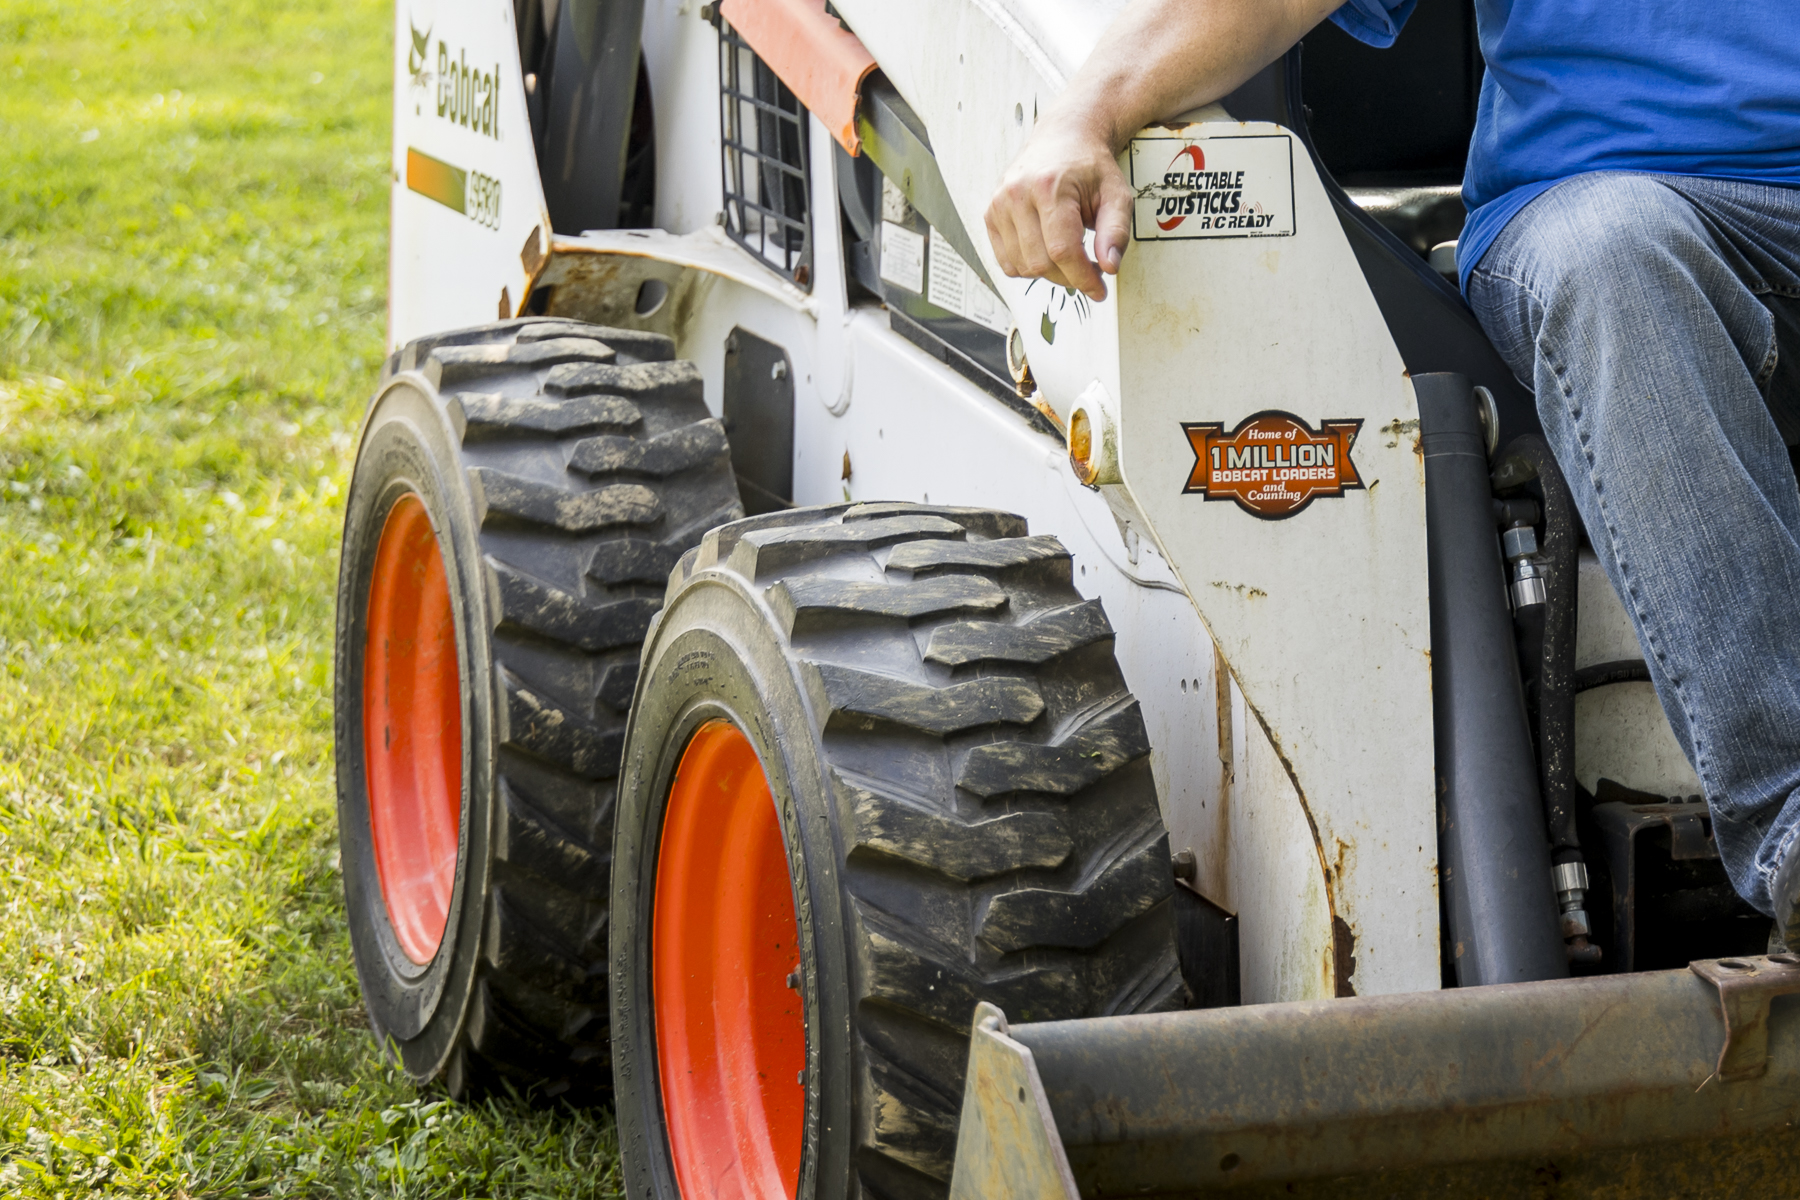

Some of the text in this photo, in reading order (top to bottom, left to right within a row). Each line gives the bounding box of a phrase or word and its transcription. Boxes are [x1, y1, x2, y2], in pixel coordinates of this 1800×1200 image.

[437, 40, 501, 141] Bobcat
[1163, 171, 1245, 189] SELECTABLE
[1156, 191, 1242, 216] JOYSTICKS
[1201, 214, 1275, 230] R/C READY
[1248, 428, 1298, 441] Home of
[1210, 443, 1335, 470] 1 MILLION
[1212, 468, 1336, 483] BOBCAT LOADERS
[1263, 482, 1286, 492] and
[1247, 490, 1301, 502] Counting
